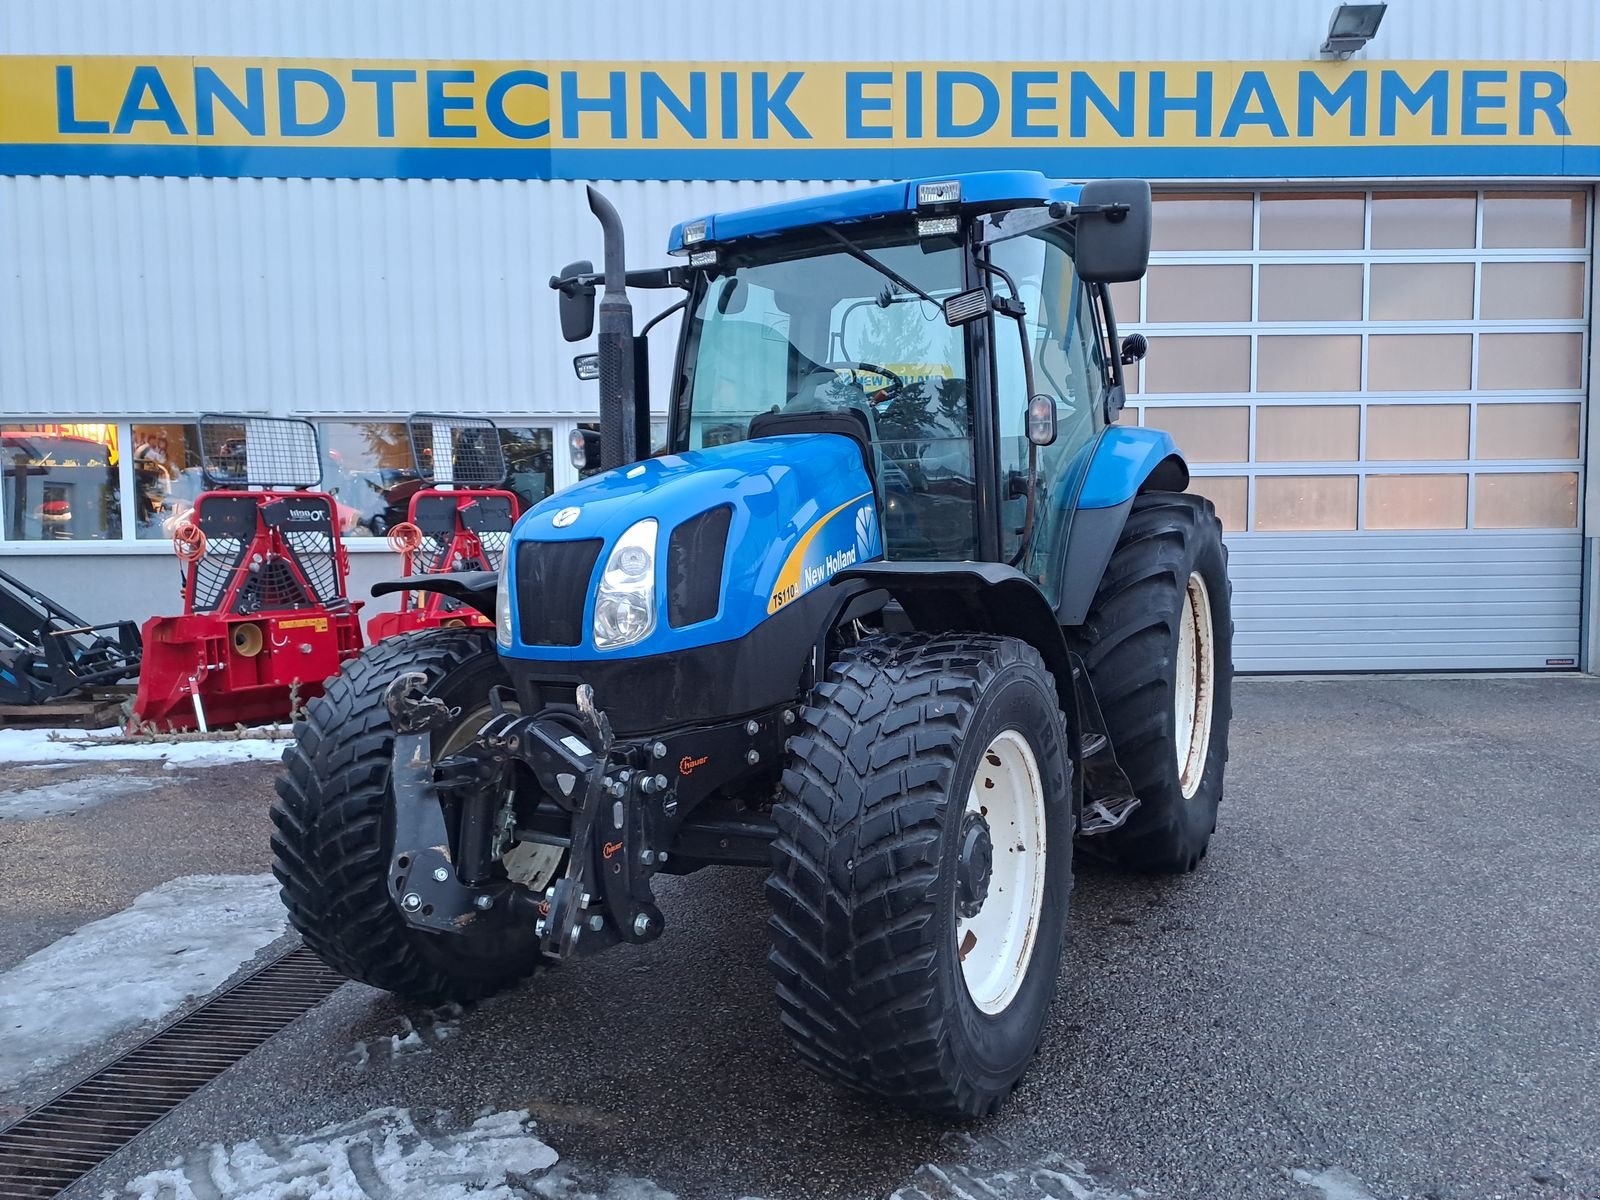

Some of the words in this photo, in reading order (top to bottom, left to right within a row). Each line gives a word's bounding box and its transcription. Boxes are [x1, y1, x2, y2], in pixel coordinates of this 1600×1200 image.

[56, 65, 811, 139] LANDTECHNIK
[845, 69, 1572, 138] EIDENHAMMER
[804, 565, 824, 589] New
[826, 544, 856, 576] Holland
